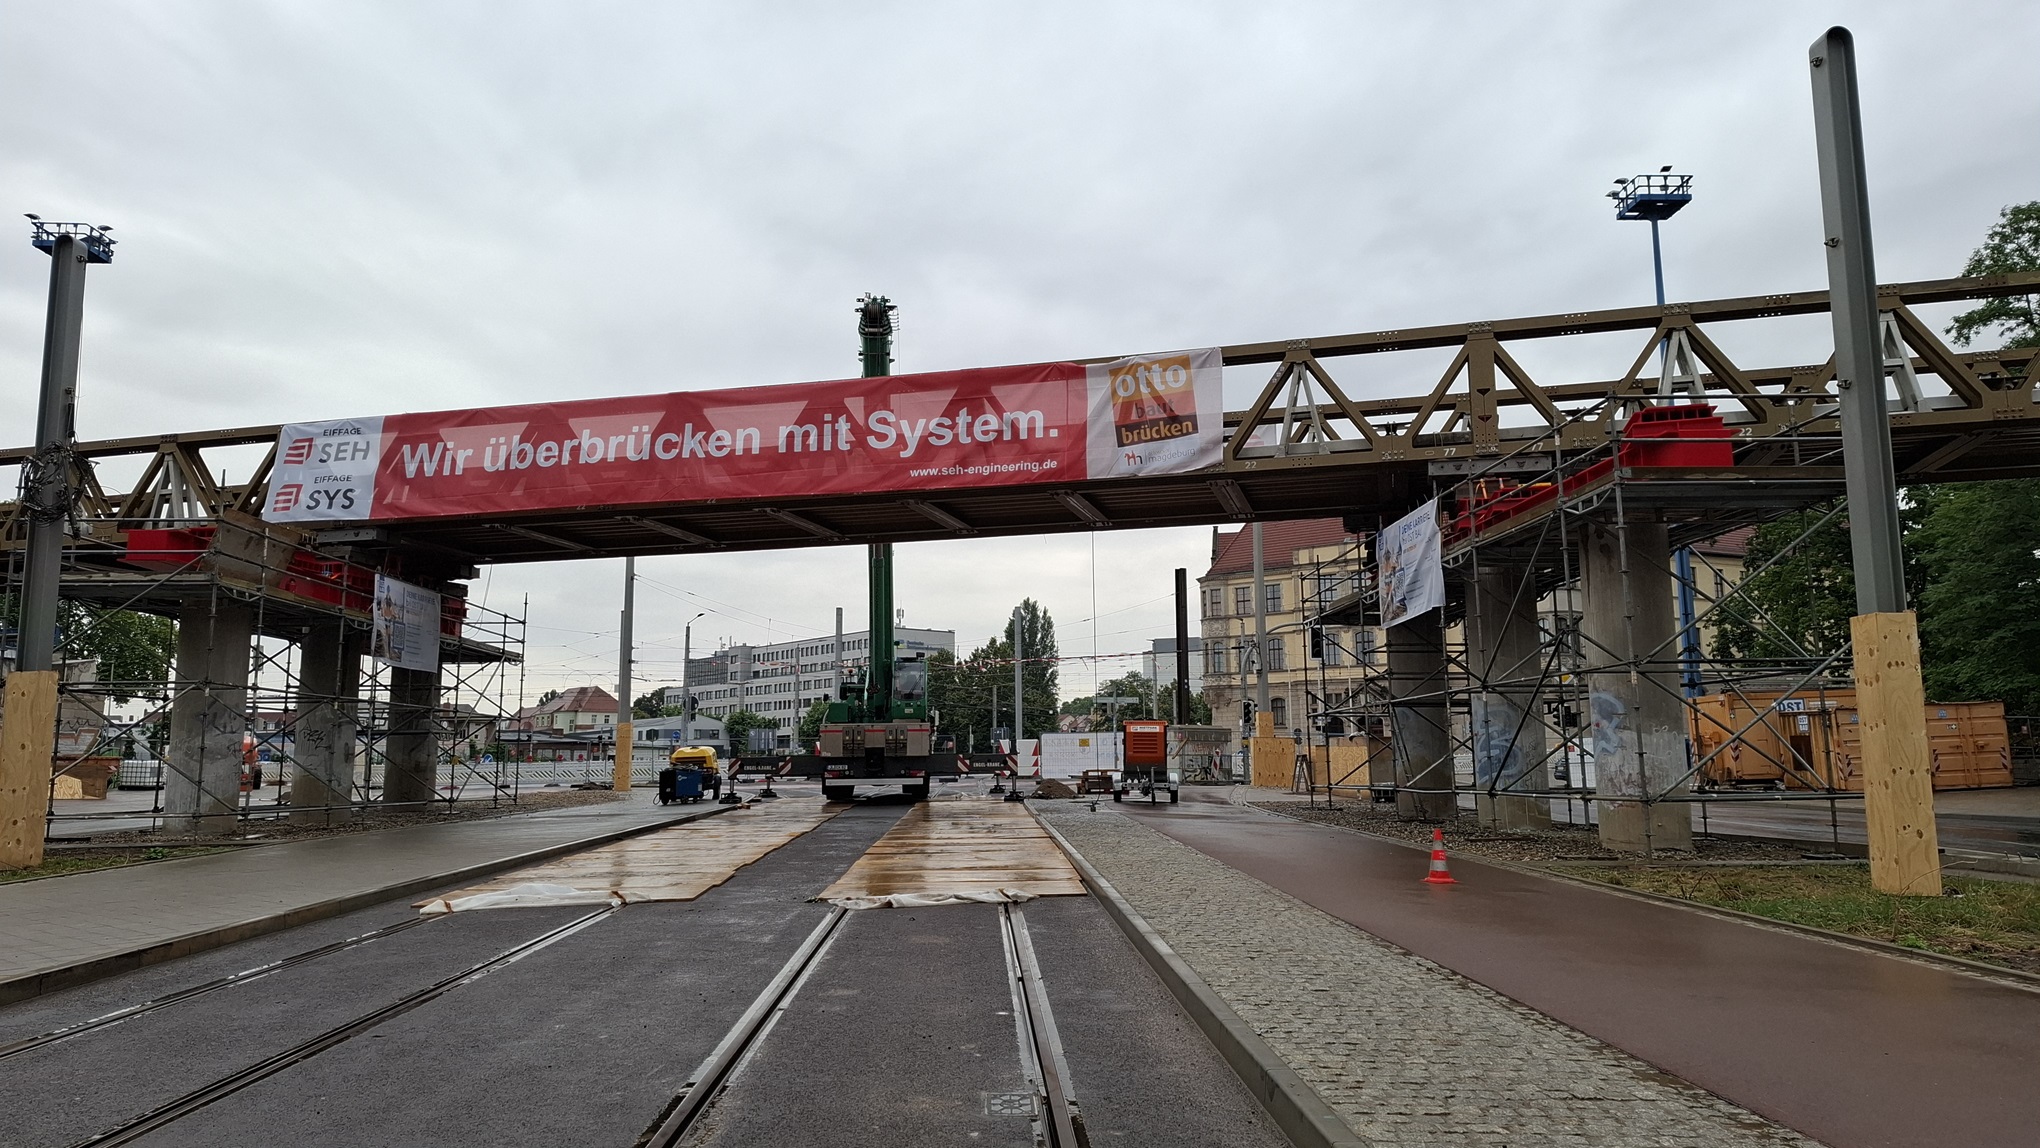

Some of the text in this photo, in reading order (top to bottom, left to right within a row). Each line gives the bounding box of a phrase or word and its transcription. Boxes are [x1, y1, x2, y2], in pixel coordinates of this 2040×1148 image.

[1115, 363, 1187, 397] otto
[1135, 399, 1175, 419] baut
[323, 427, 362, 437] EIFFAGE
[1121, 421, 1193, 444] brücken
[1739, 427, 1752, 437] 22
[402, 407, 1058, 479] Wir überbrücken mit System.
[1443, 447, 1456, 457] 77
[318, 441, 370, 464] SEH
[1148, 448, 1196, 463] magdeburg
[910, 459, 1058, 477] www.seh-engineering.de
[1244, 461, 1257, 470] 22
[314, 475, 353, 484] EIFFAGE
[306, 488, 356, 511] SYS
